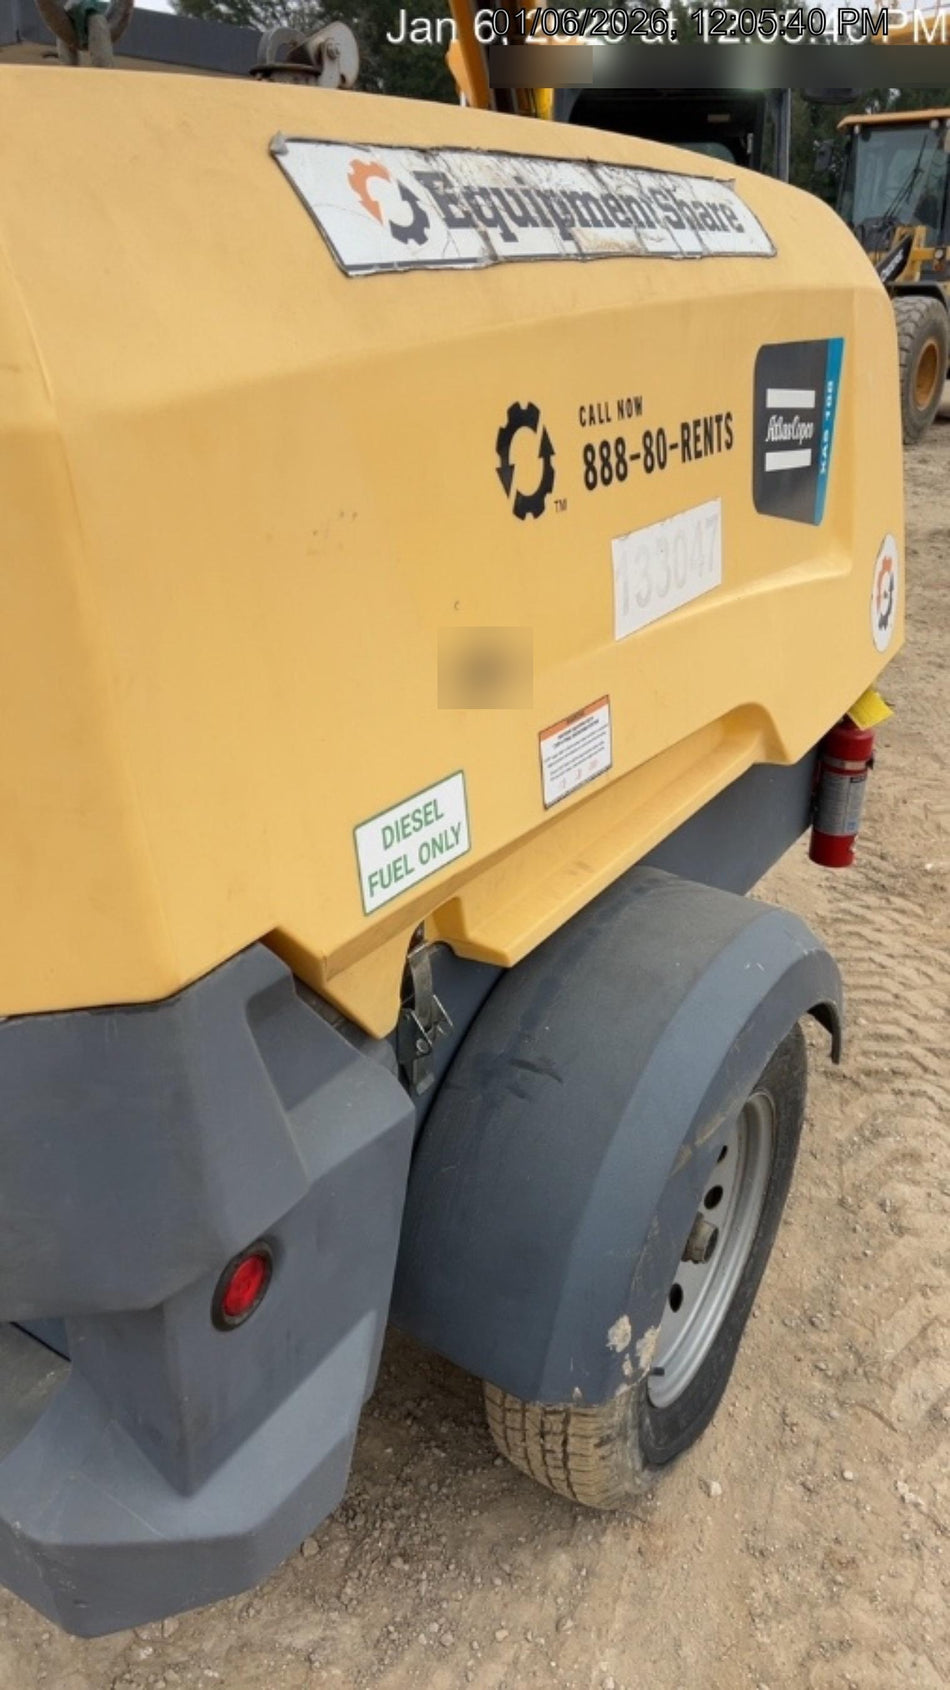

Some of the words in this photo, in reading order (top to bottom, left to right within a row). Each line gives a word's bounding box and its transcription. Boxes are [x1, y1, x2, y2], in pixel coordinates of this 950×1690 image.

[579, 400, 612, 427] CALL
[617, 396, 643, 419] NOW
[583, 411, 734, 491] 888-80-RENTS
[616, 513, 719, 617] 133047
[368, 854, 415, 898] FUEL
[418, 821, 461, 865] ONLY
[381, 798, 444, 851] DIESEL
